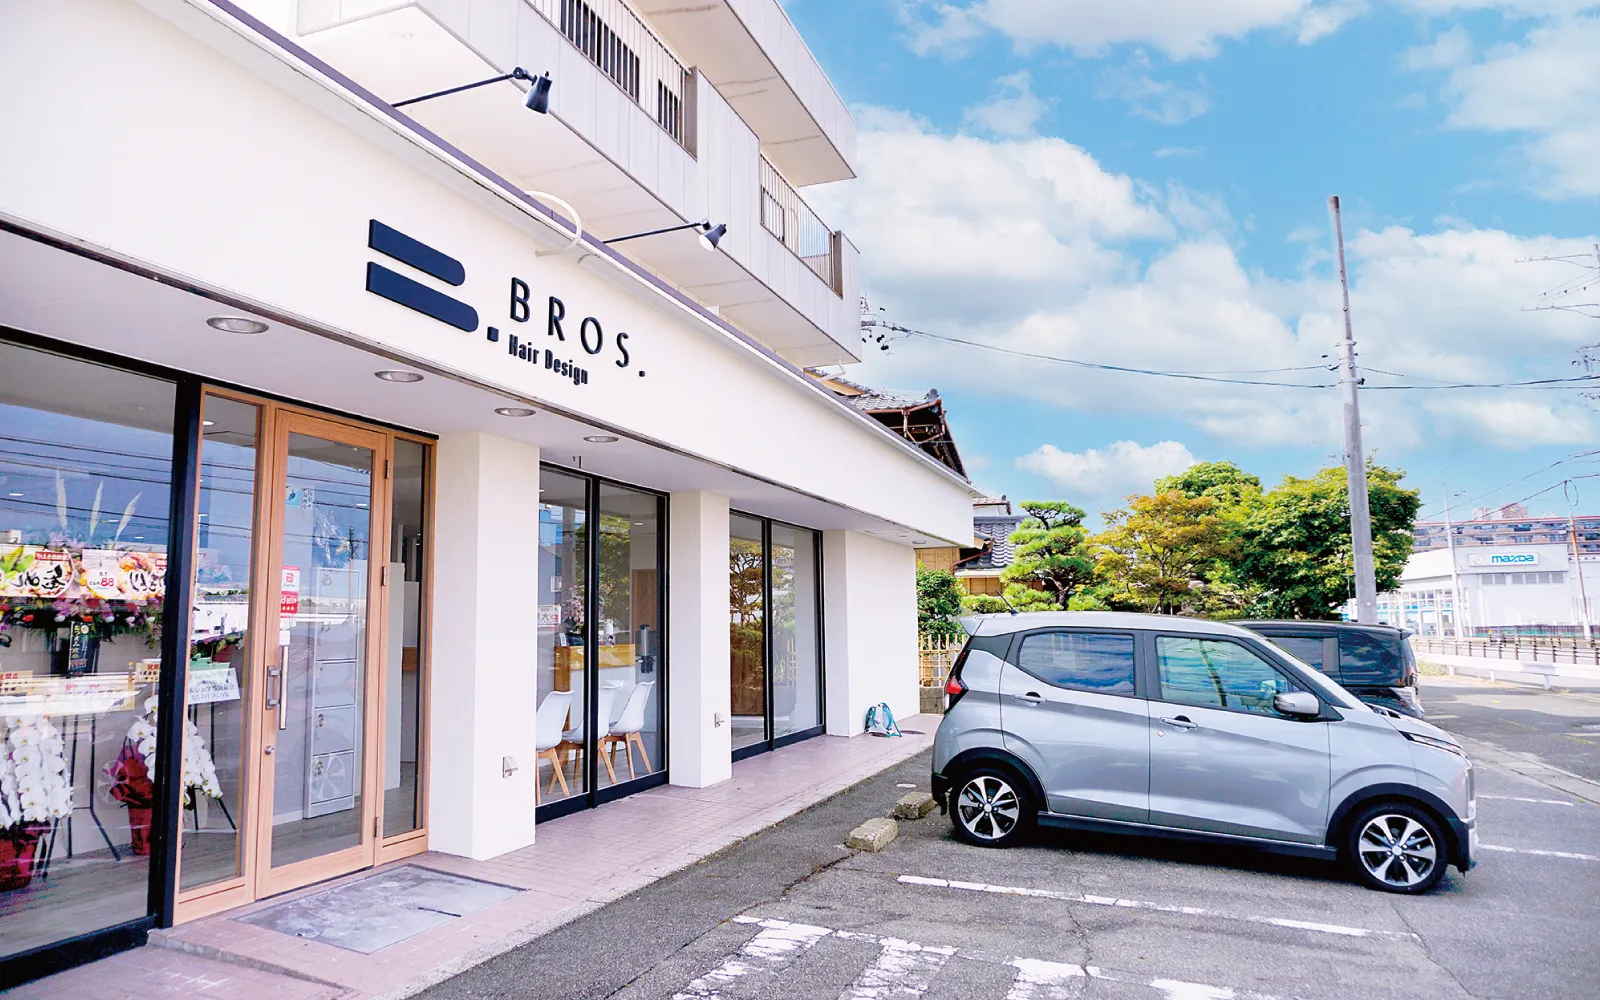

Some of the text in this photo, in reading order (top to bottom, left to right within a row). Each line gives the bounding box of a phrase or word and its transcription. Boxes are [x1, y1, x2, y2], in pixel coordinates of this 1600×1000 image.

[510, 277, 646, 378] BROS.
[508, 334, 589, 386] Hair Design
[1491, 554, 1535, 563] mazda
